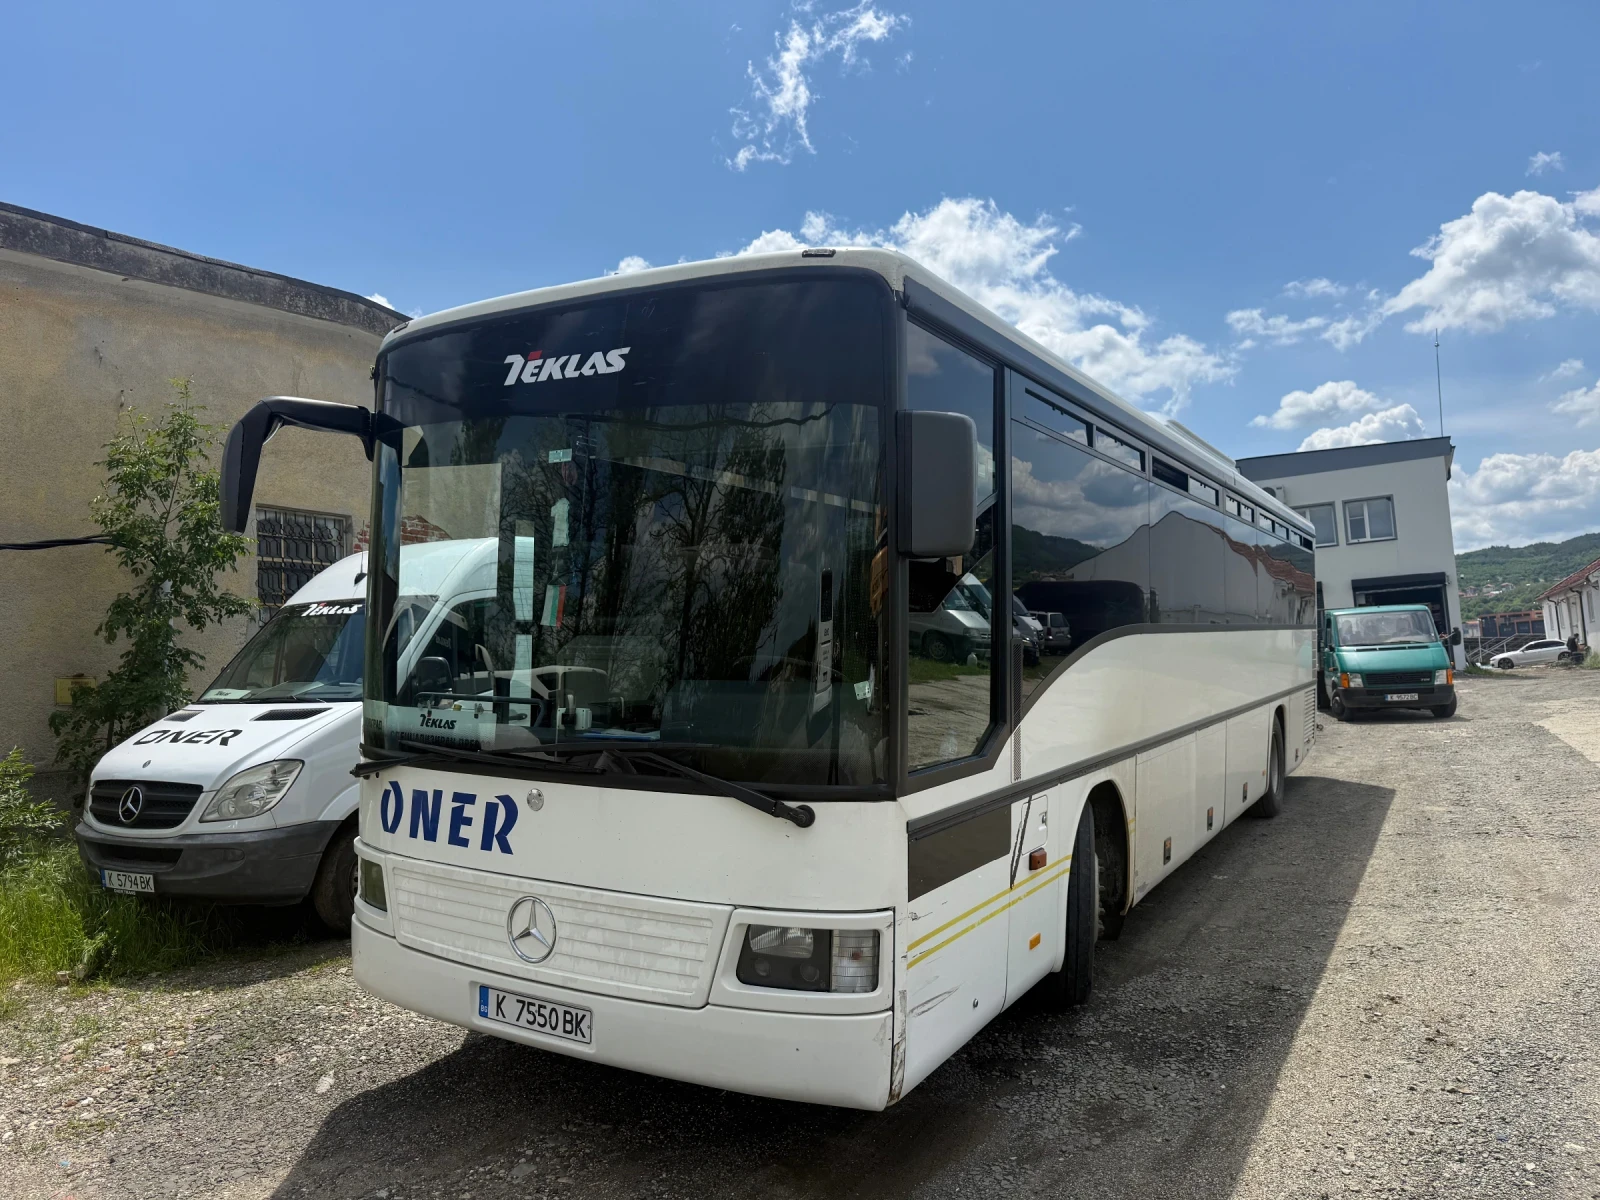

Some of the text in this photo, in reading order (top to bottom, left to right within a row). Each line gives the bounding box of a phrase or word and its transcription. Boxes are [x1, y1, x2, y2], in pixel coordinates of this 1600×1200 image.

[504, 347, 631, 386] TEKLAS
[301, 602, 363, 617] TEKLAS
[419, 713, 457, 730] TEKLAS
[133, 729, 243, 746] ONER
[381, 781, 518, 855] ONER
[107, 872, 114, 886] K
[480, 1004, 488, 1013] BG
[495, 993, 507, 1019] K
[516, 999, 559, 1031] 7550
